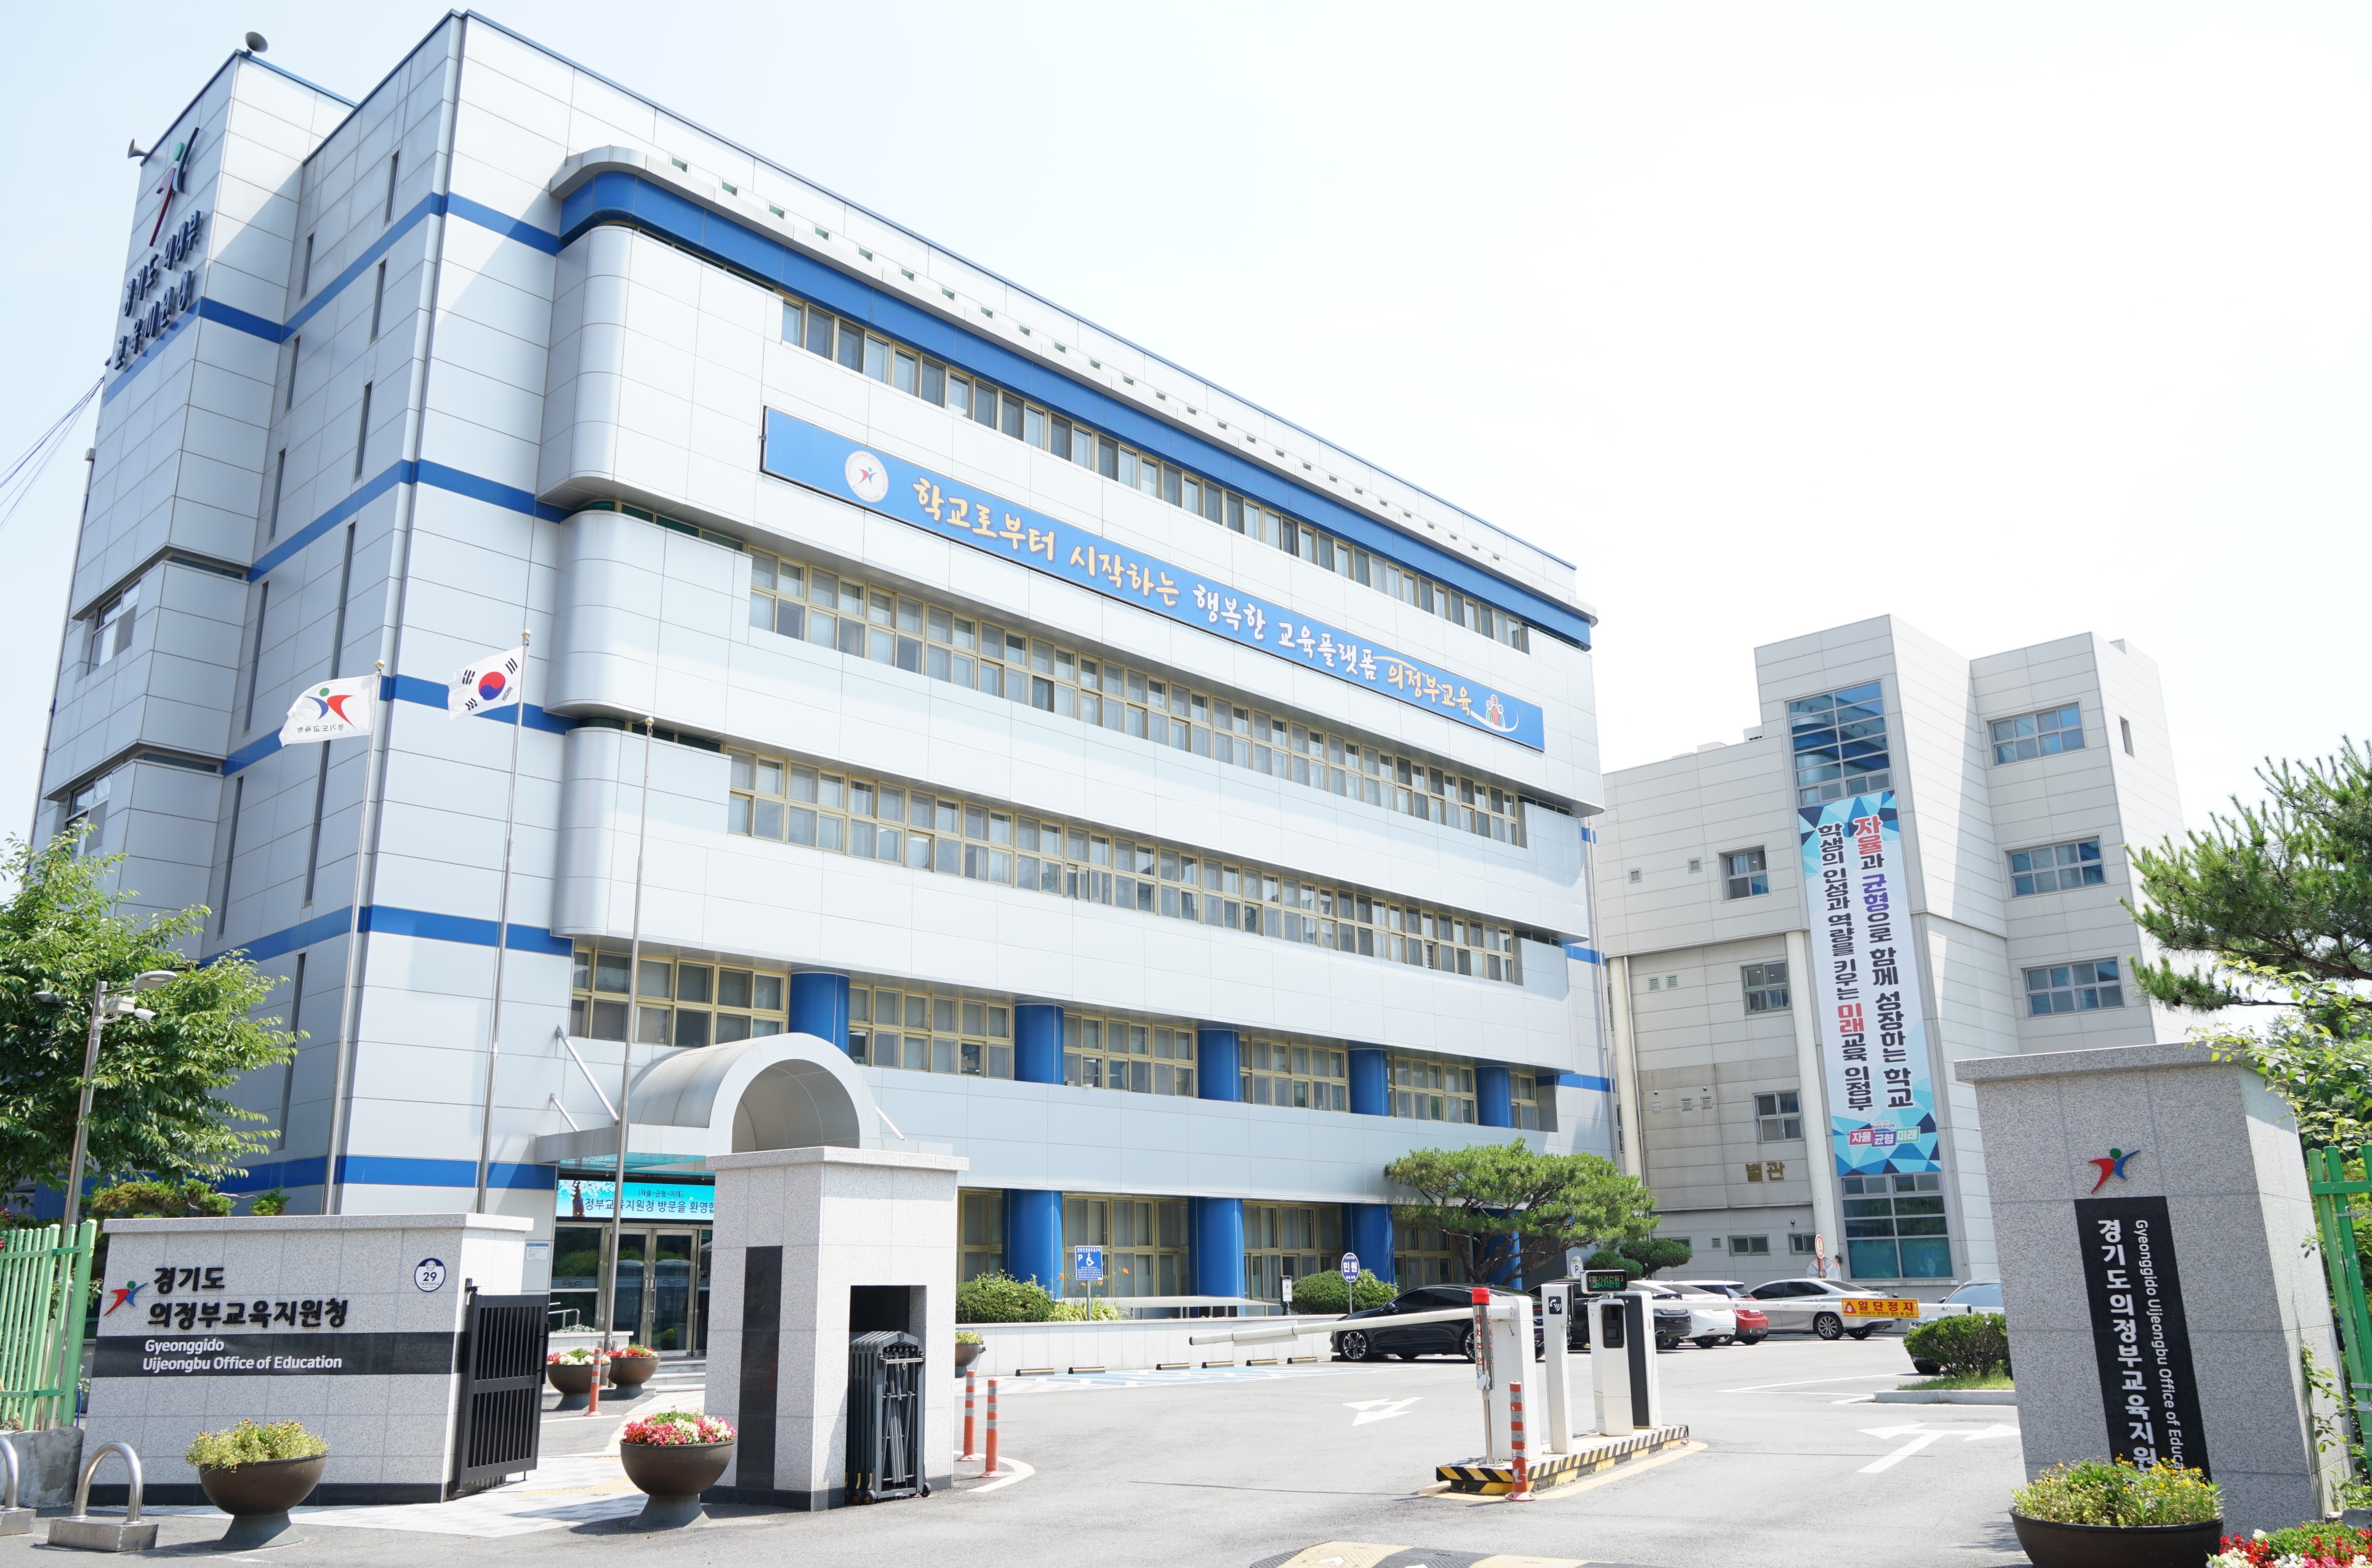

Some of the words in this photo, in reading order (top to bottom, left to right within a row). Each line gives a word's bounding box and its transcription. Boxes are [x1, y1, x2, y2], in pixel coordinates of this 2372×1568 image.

[164, 210, 201, 271] 의정부
[113, 270, 193, 370] 교육지원청
[912, 476, 1055, 561] 학교로부터
[1070, 545, 1180, 606] 시작하는
[1192, 583, 1266, 640] 행복한
[1277, 622, 1377, 681] 교육플랫폼
[1388, 663, 1472, 716] 의정부교육
[1817, 822, 1844, 866] 학생의
[1854, 816, 1884, 870] 자율과
[1823, 867, 1851, 911] 인성과
[1862, 873, 1893, 944] 균형으로
[1828, 912, 1855, 957] 역량을
[1833, 959, 1859, 1001] 키우는
[1869, 946, 1899, 986] 함께
[1837, 1002, 1868, 1062] 미래교육
[1875, 991, 1907, 1063] 성장하는
[1844, 1066, 1873, 1111] 의정부
[1883, 1067, 1914, 1108] 학교
[1852, 1132, 1871, 1143] 자율
[1874, 1133, 1894, 1145] 균형
[1897, 1129, 1918, 1141] 미래
[1745, 1160, 1785, 1183] 별관
[657, 1200, 686, 1213] 방문을
[423, 1272, 437, 1282] 29
[1077, 1254, 1083, 1262] P
[1343, 1261, 1357, 1272] 민원
[1575, 1264, 1579, 1274] P
[2134, 1220, 2159, 1296] Gyeonggido
[154, 1266, 225, 1295] 경기도
[147, 1298, 348, 1330] 의정부교육지원청
[2146, 1298, 2169, 1365] Uijeongbu
[142, 1356, 211, 1373] Uijeongbu
[213, 1356, 254, 1370] Office
[256, 1356, 272, 1369] of
[273, 1355, 342, 1369] Education
[145, 1338, 225, 1354] Gyeonggido
[2158, 1369, 2176, 1408] Office
[2166, 1411, 2181, 1426] of
